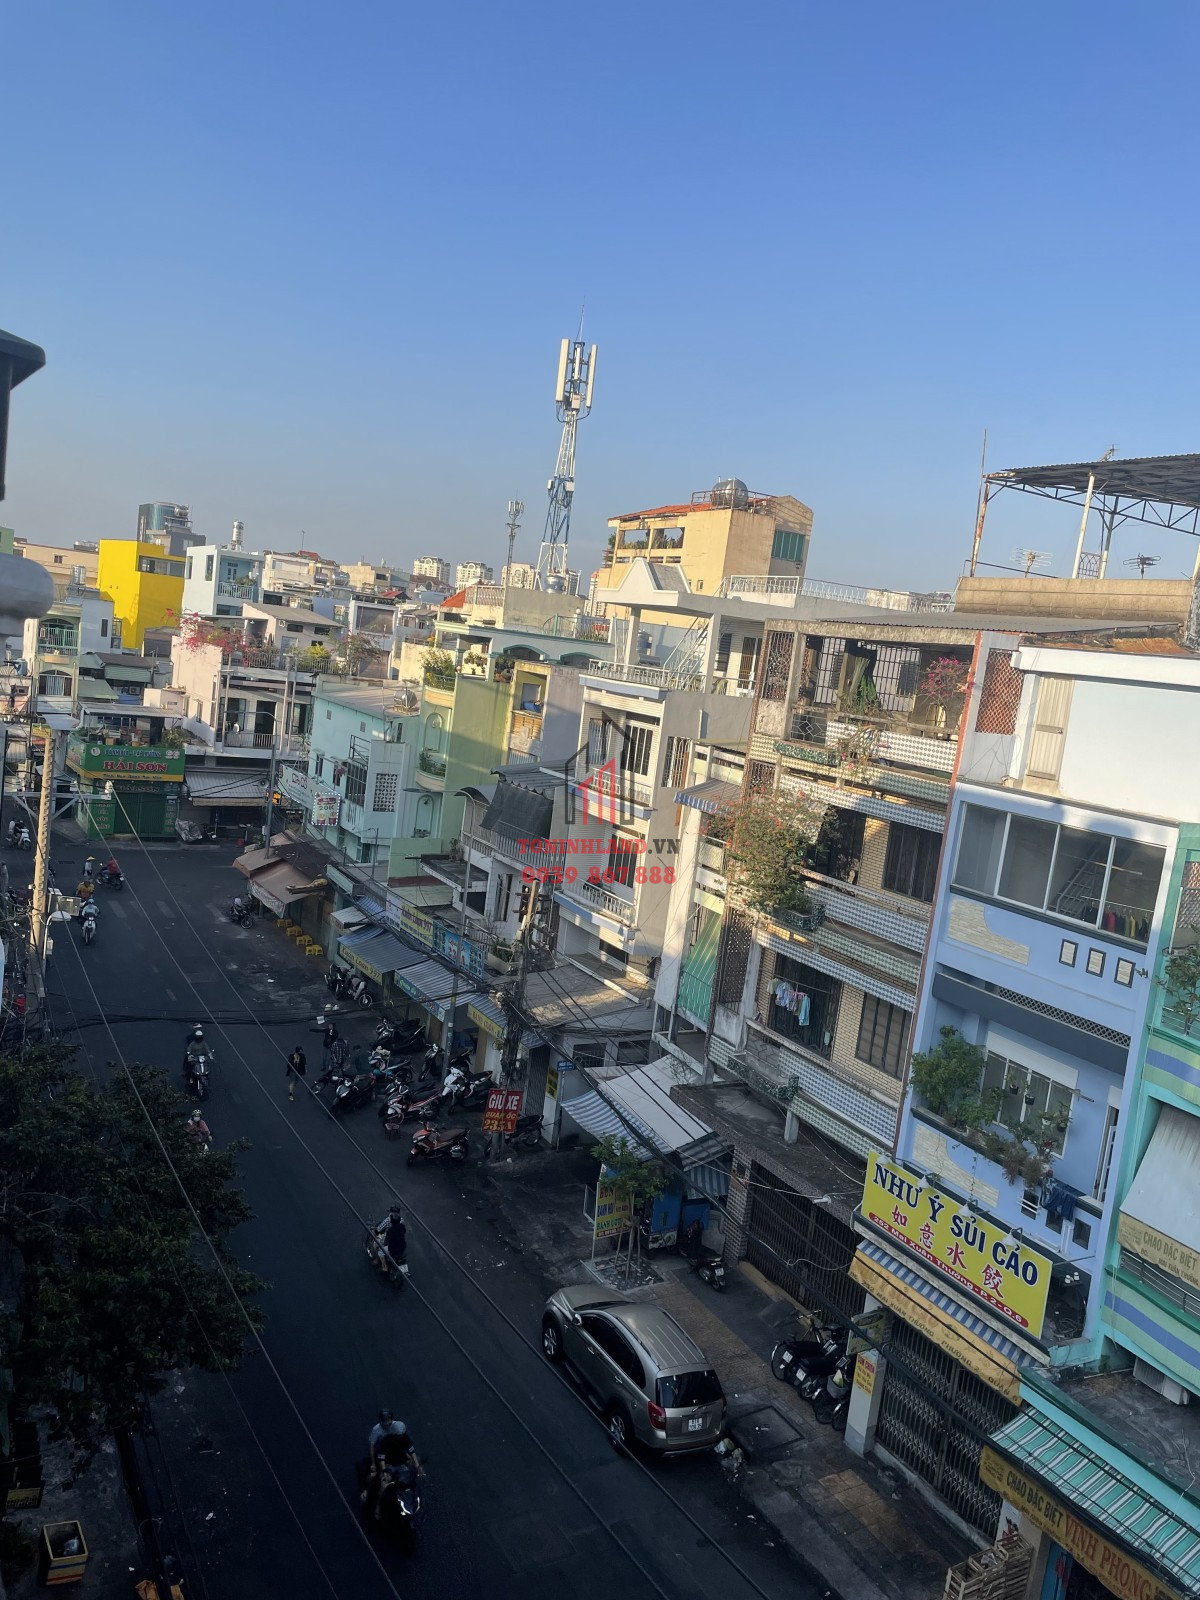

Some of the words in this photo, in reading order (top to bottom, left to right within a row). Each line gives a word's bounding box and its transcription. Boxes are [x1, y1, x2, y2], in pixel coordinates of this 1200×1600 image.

[103, 757, 133, 770] HẢI
[136, 761, 167, 772] SƠN
[505, 1095, 520, 1110] XE
[873, 1163, 923, 1208] NHƯ
[928, 1194, 945, 1223] Ý
[950, 1214, 986, 1253] SỦI
[992, 1241, 1038, 1286] CẢO
[874, 1216, 889, 1230] 252
[891, 1228, 907, 1243] Mai
[909, 1241, 933, 1261] Xuân
[876, 1292, 889, 1303] MAI
[1100, 1545, 1152, 1600] PHONG
